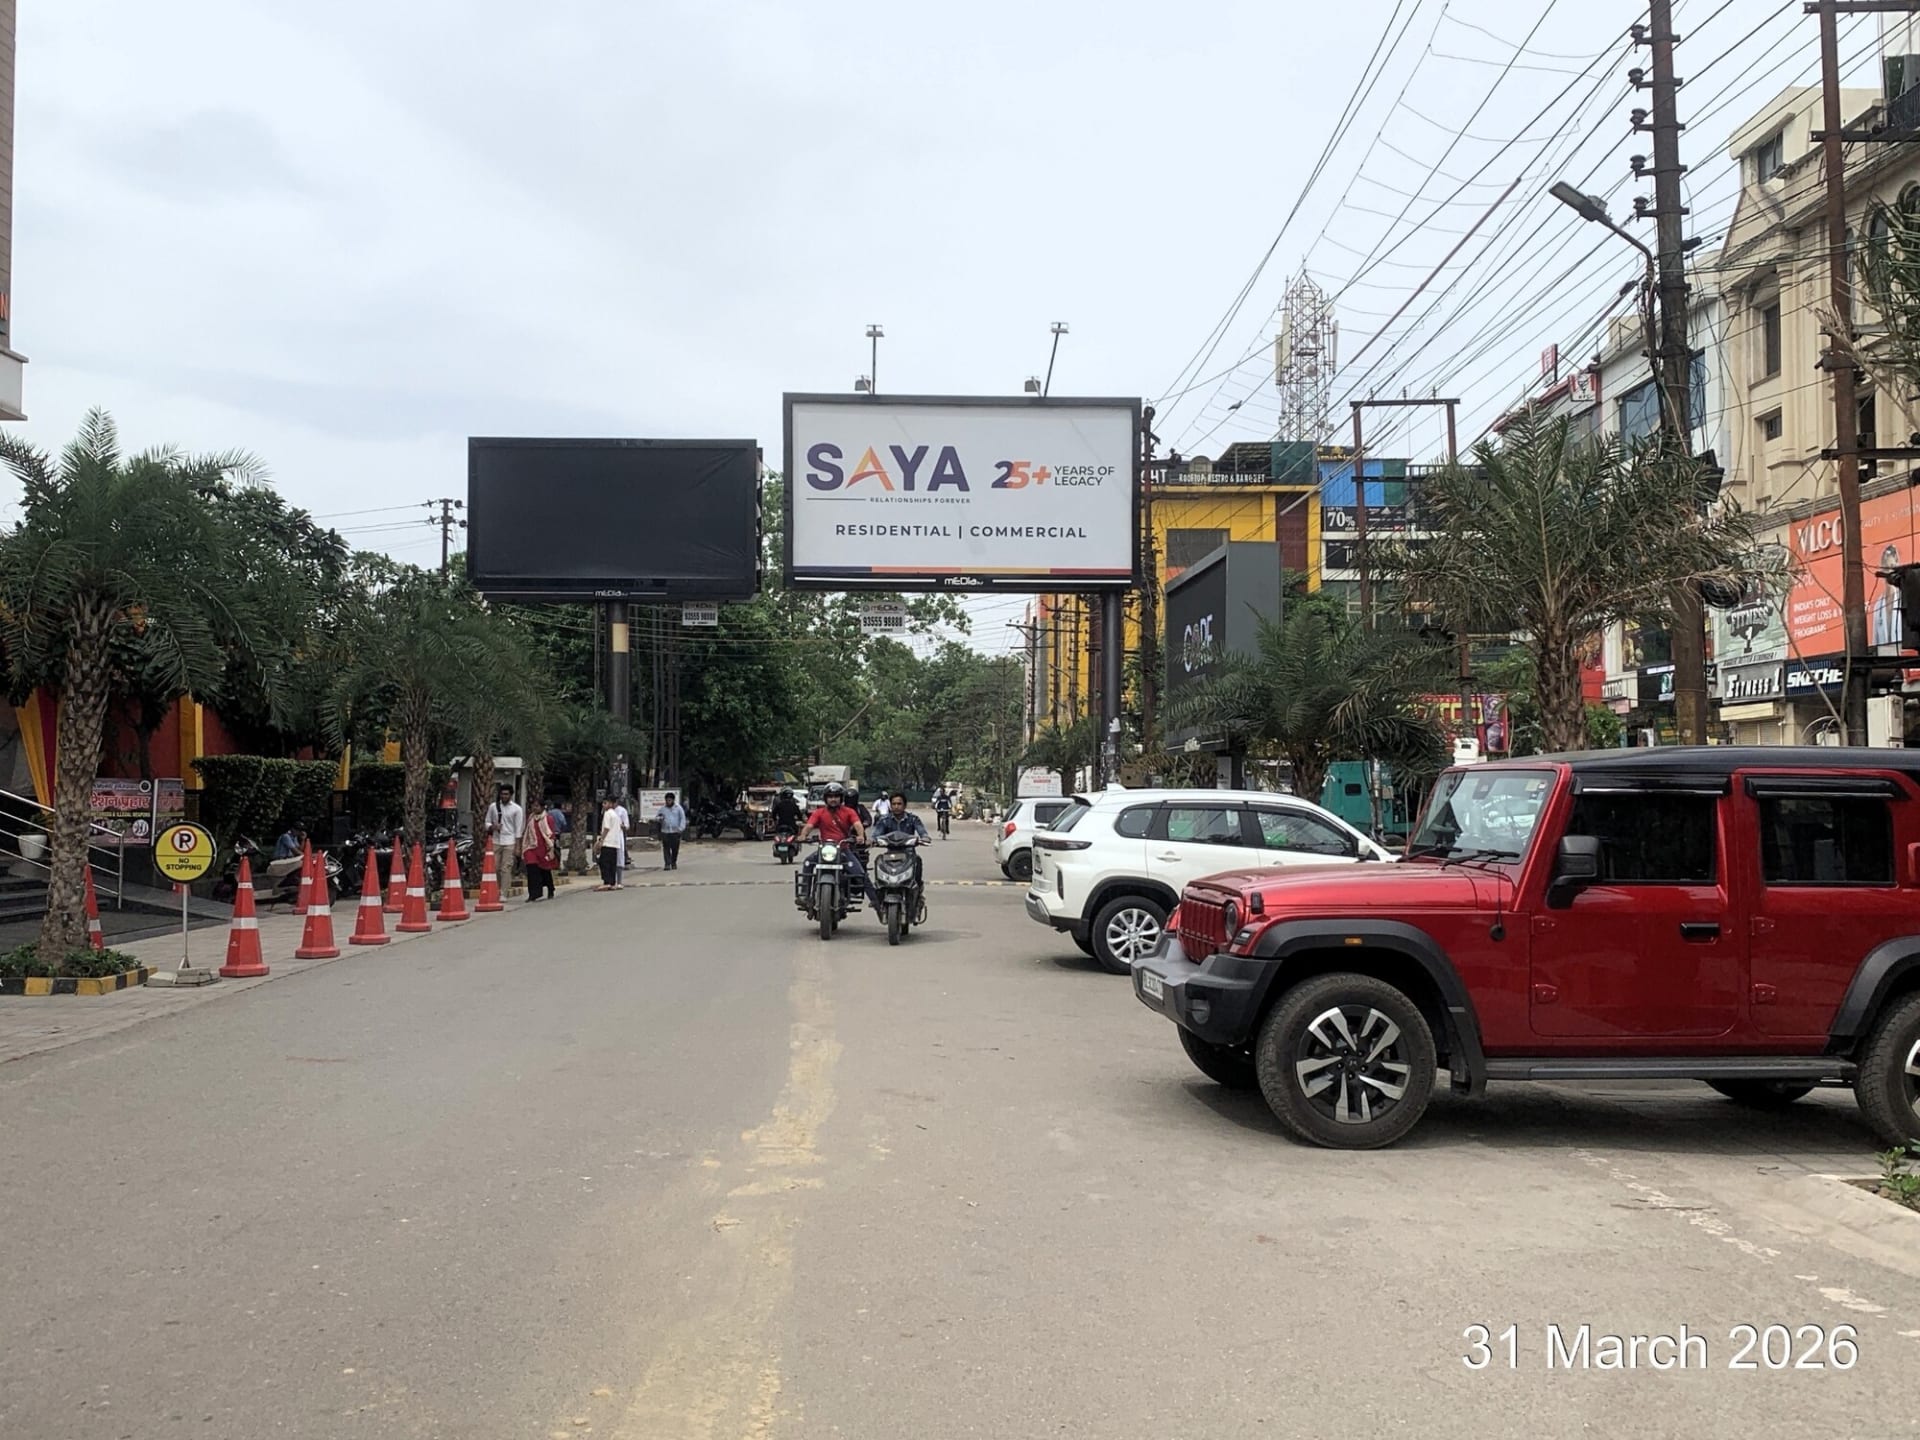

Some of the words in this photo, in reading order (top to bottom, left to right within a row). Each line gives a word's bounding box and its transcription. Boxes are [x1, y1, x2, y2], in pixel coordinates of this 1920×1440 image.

[806, 443, 971, 492] SAYA
[991, 460, 1052, 489] 25+
[1054, 465, 1094, 476] YEARS
[1097, 465, 1116, 476] OF
[1054, 476, 1103, 486] LEGACY
[836, 524, 951, 537] RESIDENTIAL
[970, 526, 1087, 538] COMMERCIAL
[1726, 674, 1771, 698] FITNESS
[1772, 667, 1783, 692] 1
[1786, 667, 1844, 688] SKECHE
[166, 863, 202, 871] STOPPING
